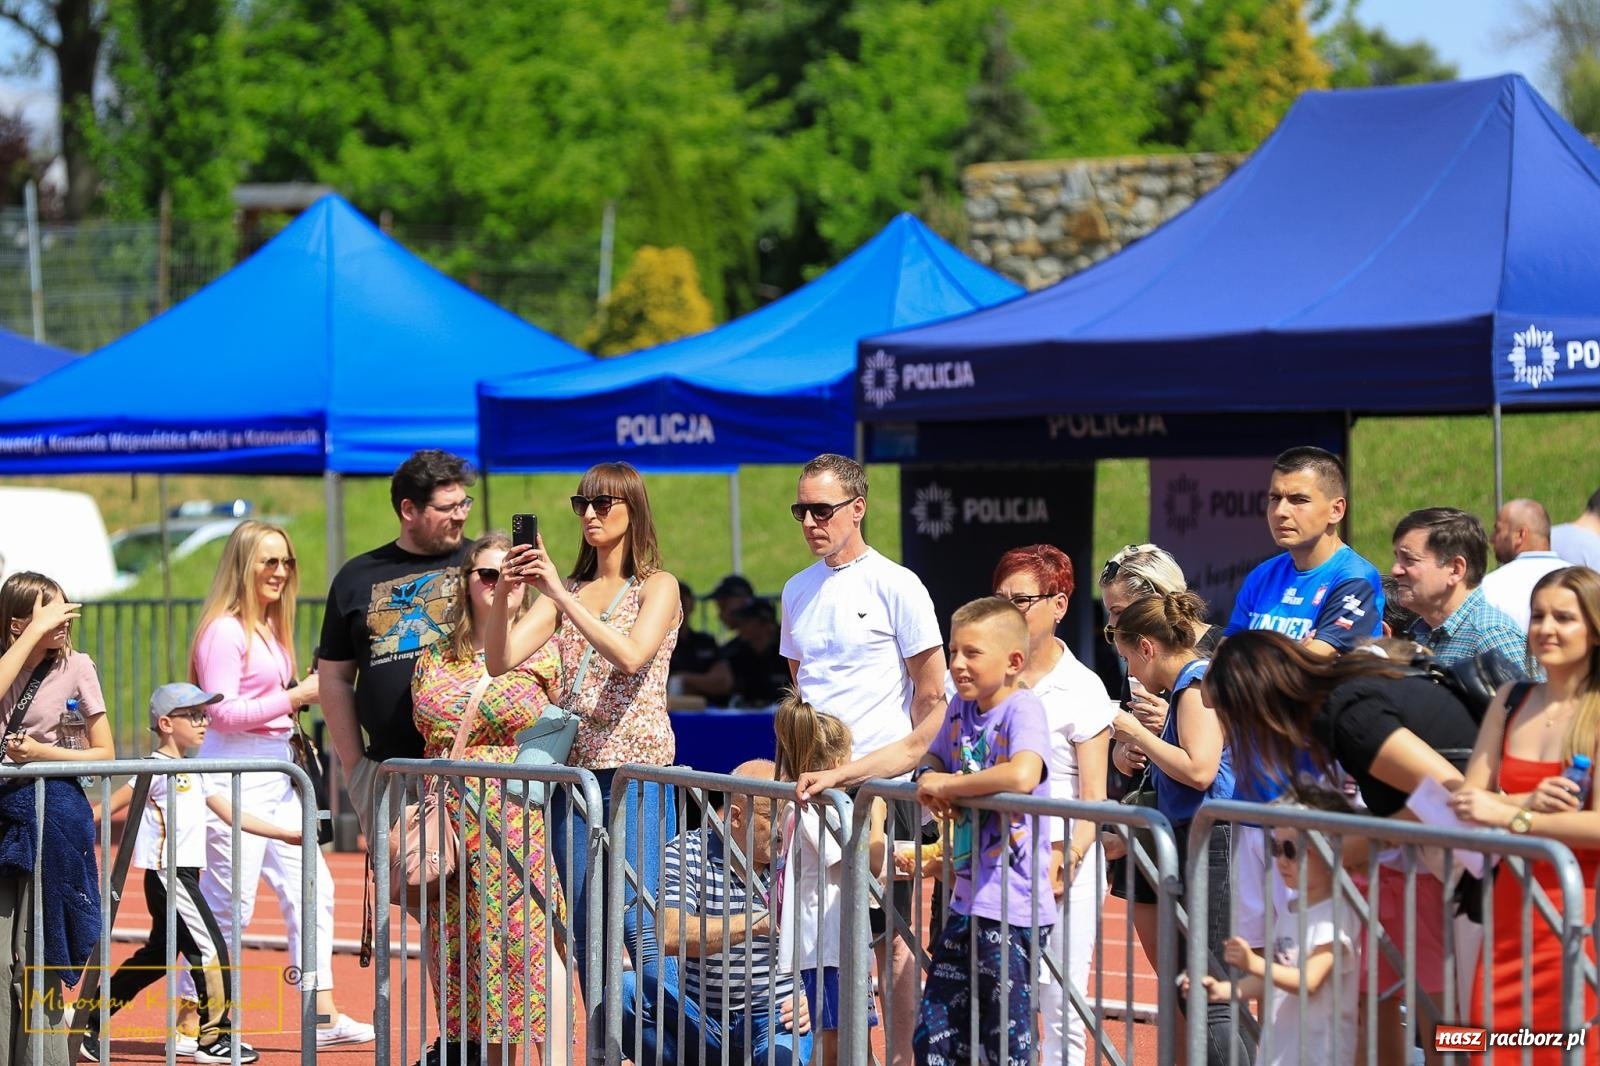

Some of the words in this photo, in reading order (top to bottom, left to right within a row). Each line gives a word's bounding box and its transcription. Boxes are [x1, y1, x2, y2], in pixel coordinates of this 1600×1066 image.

[1566, 340, 1600, 369] PO
[902, 360, 975, 391] POLICJA
[616, 412, 715, 446] POLICJA
[963, 497, 1049, 523] POLICJA
[1210, 489, 1268, 518] POLIC
